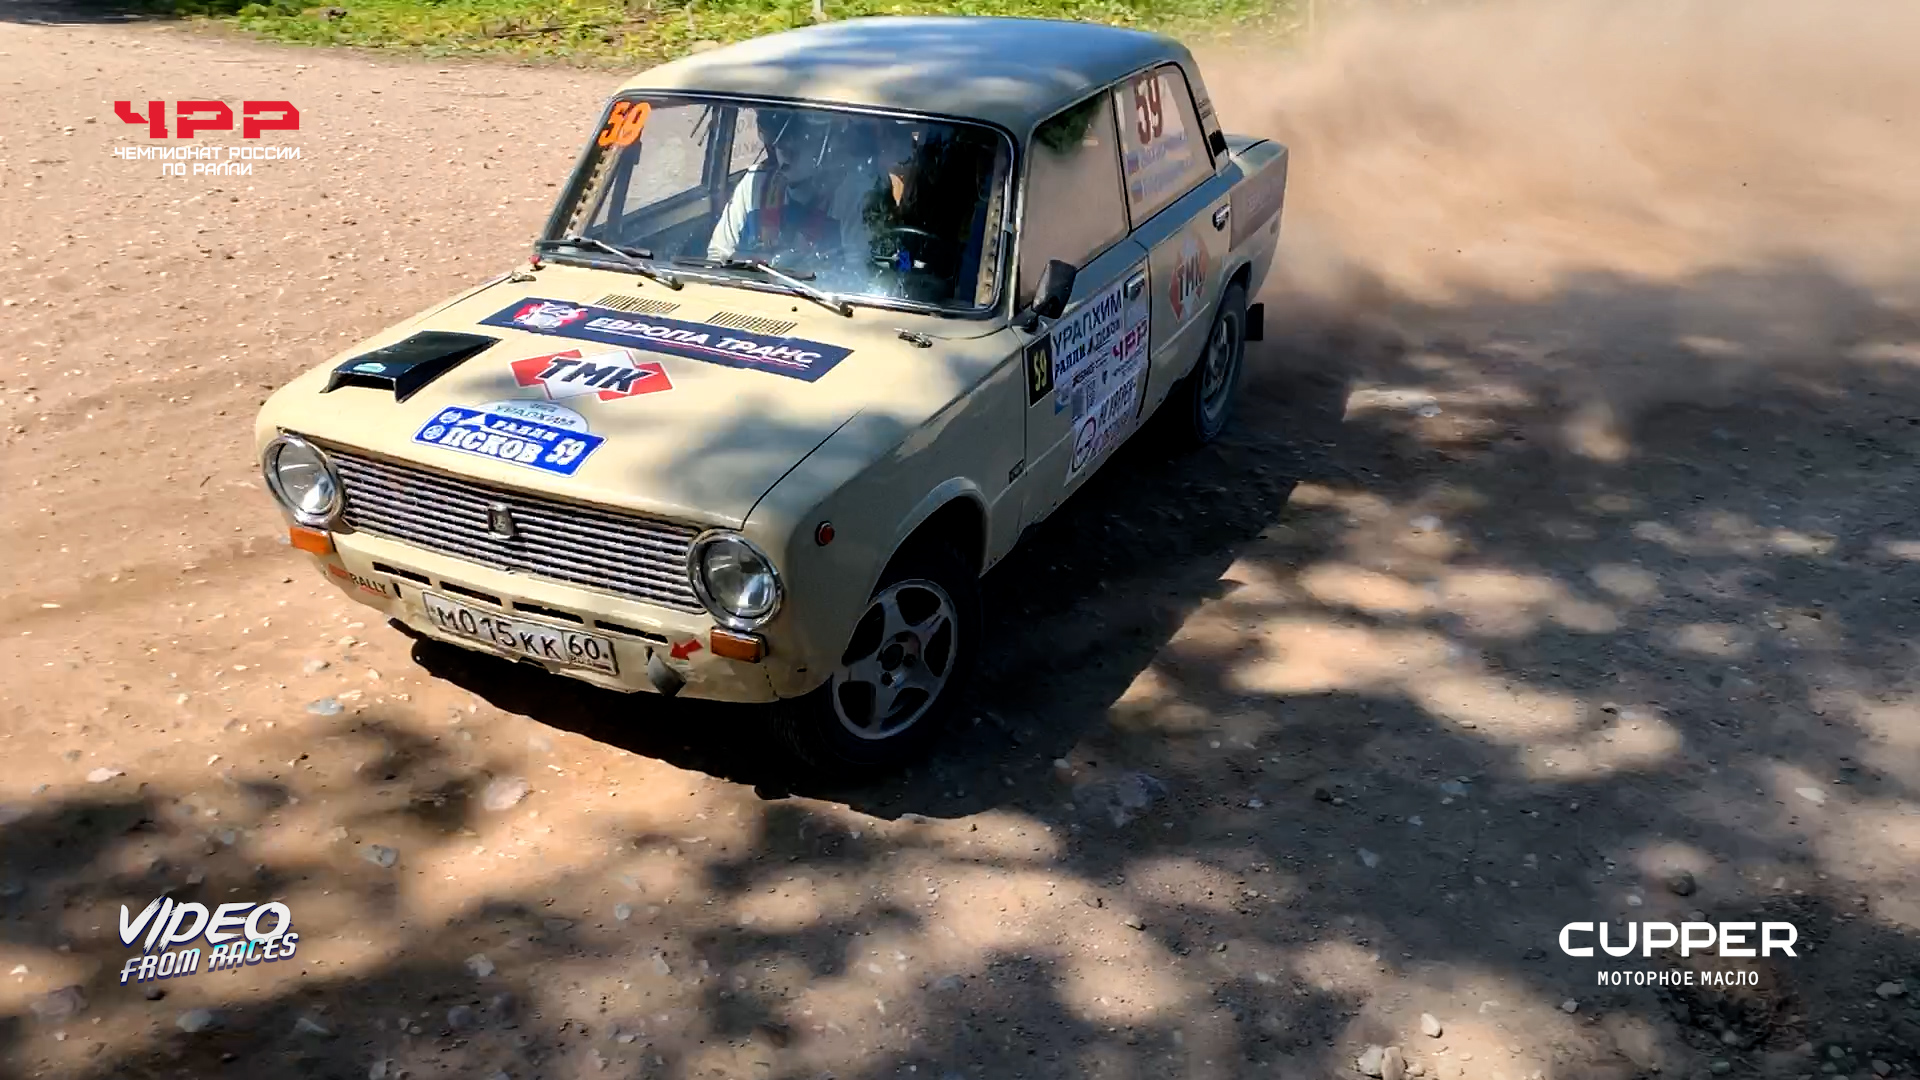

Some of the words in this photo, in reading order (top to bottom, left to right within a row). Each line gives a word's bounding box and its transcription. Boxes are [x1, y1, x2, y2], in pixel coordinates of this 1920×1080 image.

[598, 101, 651, 147] 59
[1133, 72, 1163, 145] 59
[585, 316, 710, 345] ЕВРОПА
[715, 336, 823, 364] ТРАНС
[537, 357, 655, 393] ТМК
[1033, 348, 1047, 392] 59
[438, 427, 544, 464] ПСКОВ
[544, 438, 587, 467] 59
[349, 572, 388, 595] RALLY
